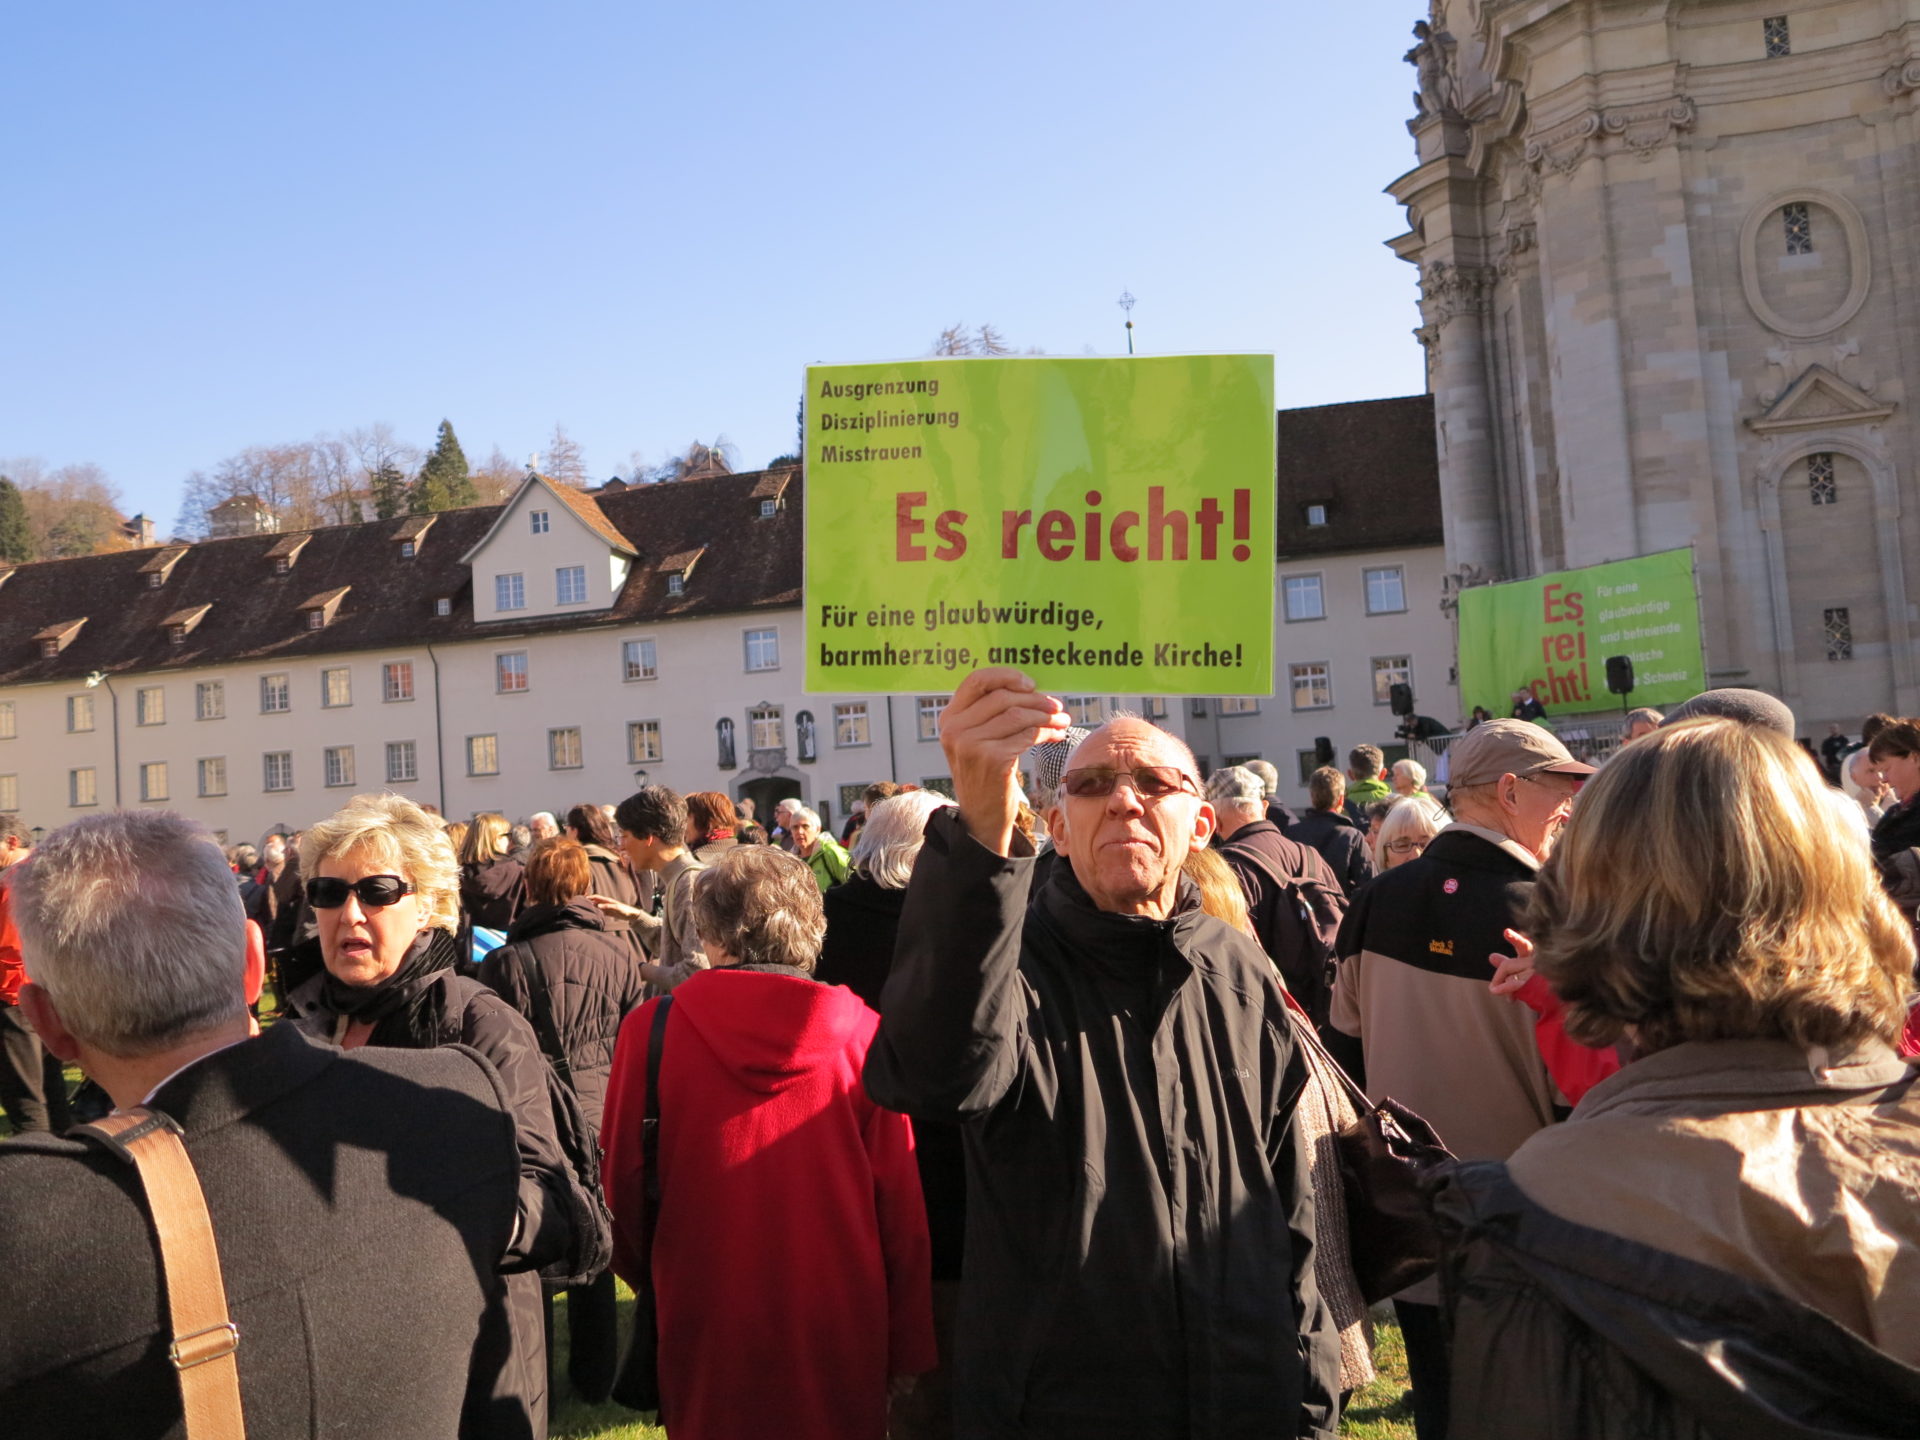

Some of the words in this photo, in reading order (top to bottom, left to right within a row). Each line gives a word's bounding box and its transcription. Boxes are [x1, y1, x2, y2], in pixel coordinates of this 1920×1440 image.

[821, 380, 939, 401] Ausgrenzung
[821, 409, 960, 433] Disziplinierung
[821, 445, 922, 463] Misstrauen
[896, 491, 969, 562] Es
[1001, 485, 1251, 563] reicht!
[1597, 585, 1613, 598] Für
[1615, 583, 1639, 594] eine
[1543, 583, 1585, 624] Es
[1599, 601, 1670, 623] glaubwürdige
[821, 605, 858, 628] Für
[866, 604, 915, 627] eine
[924, 600, 1104, 632] glaubwürdige,
[1541, 620, 1587, 664] rei
[1600, 631, 1620, 643] und
[1623, 623, 1681, 641] befreiende
[820, 642, 979, 670] barmherzige,
[988, 641, 1144, 667] ansteckende
[1153, 642, 1243, 667] Kirche!
[1530, 661, 1592, 706] cht!
[1643, 669, 1688, 685] Schweiz
